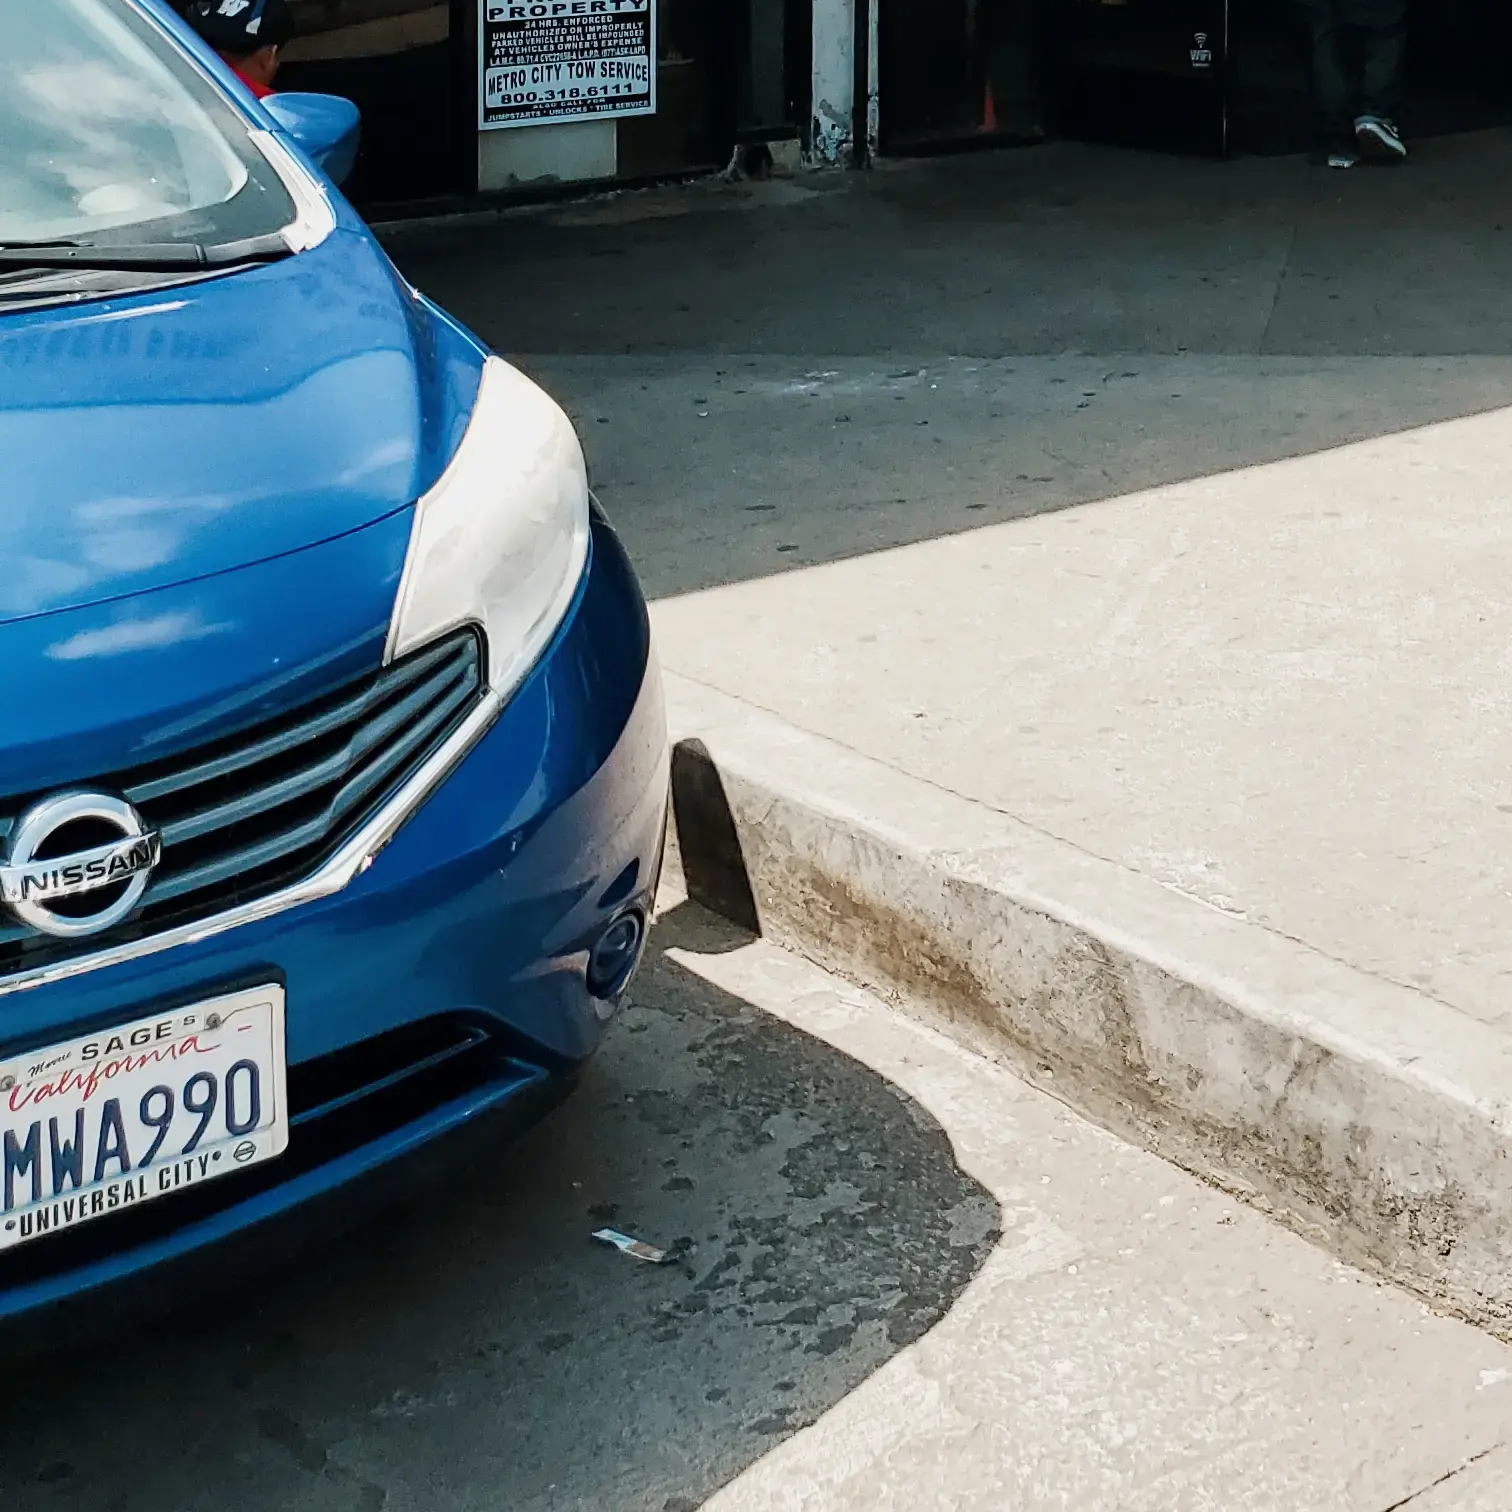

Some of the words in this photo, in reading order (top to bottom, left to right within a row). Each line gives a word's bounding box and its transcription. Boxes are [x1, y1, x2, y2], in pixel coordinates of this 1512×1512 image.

[492, 28, 568, 41] UNAUTHORIZED
[569, 26, 583, 35] OR
[585, 22, 644, 34] IMPROPERLY
[524, 20, 537, 29] 24
[563, 15, 613, 27] ENFORCED
[491, 39, 524, 48] PARKED
[525, 36, 565, 46] VEHICLES
[566, 34, 585, 43] WILL
[598, 30, 645, 40] IMPOUNDED
[494, 48, 506, 56] AT
[601, 37, 643, 48] EXPENSE
[488, 69, 527, 96] METRO
[531, 63, 562, 84] CITY
[567, 61, 596, 79] TOW
[600, 61, 648, 82] SERVICE
[501, 83, 633, 104] 800.318.6111
[487, 110, 541, 121] JUMPSTARTS
[616, 100, 648, 110] SERVICE
[22, 841, 157, 900] NISSAN
[9, 1035, 221, 1111] California
[19, 1176, 147, 1238] UNIVERSAL
[158, 1153, 210, 1191] CITY
